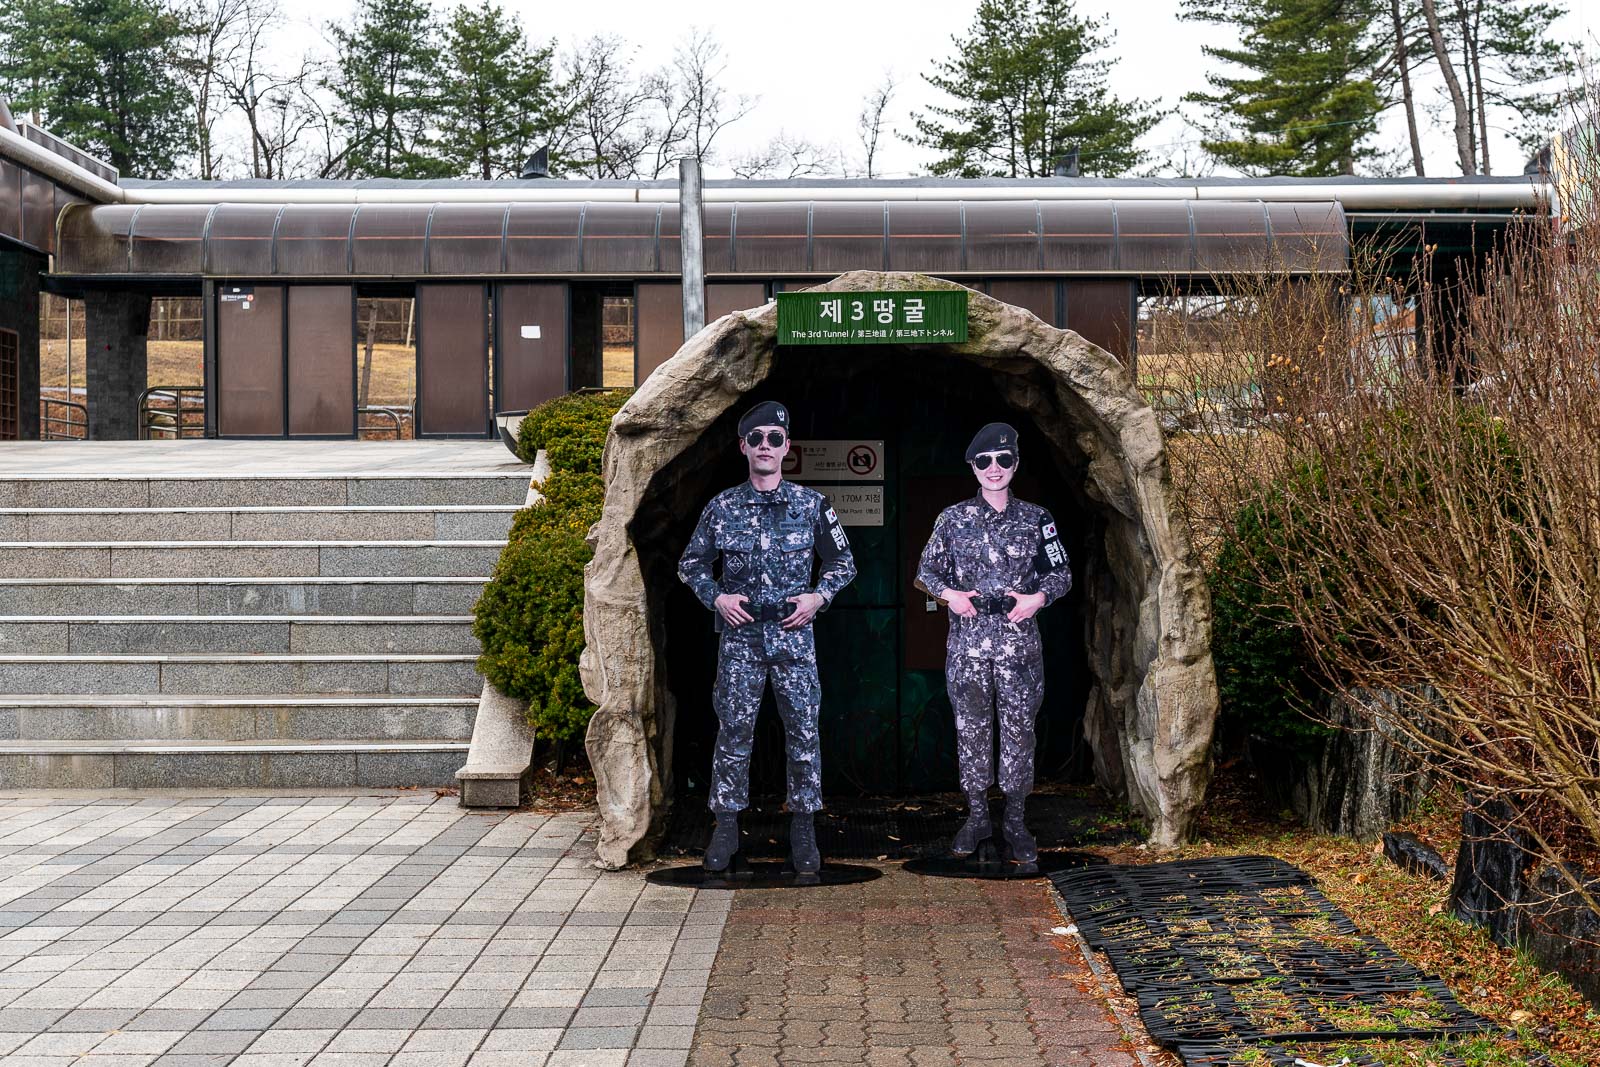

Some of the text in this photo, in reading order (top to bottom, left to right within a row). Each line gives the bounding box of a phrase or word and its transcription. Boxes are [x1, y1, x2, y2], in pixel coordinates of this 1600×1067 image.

[792, 330, 806, 338] The
[807, 330, 821, 338] 3rd
[822, 330, 849, 338] Tunnel
[841, 494, 862, 503] 170M
[865, 493, 880, 503] 지점
